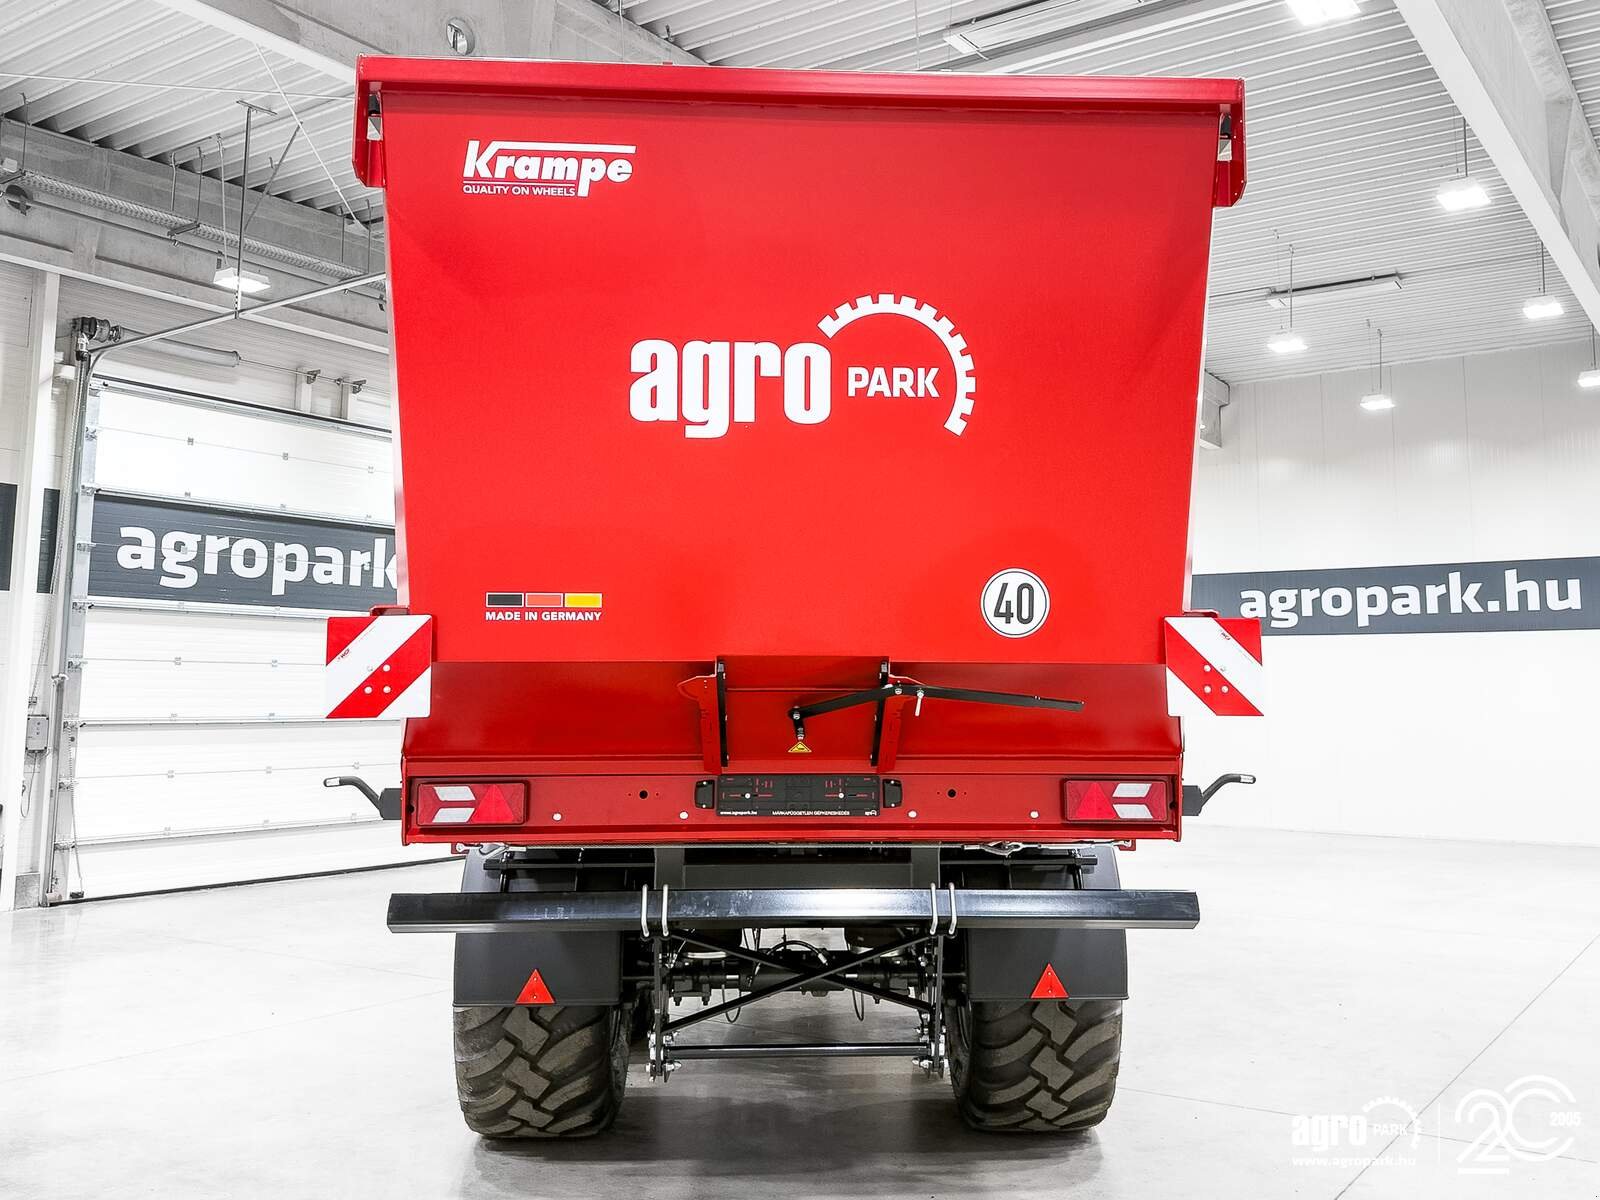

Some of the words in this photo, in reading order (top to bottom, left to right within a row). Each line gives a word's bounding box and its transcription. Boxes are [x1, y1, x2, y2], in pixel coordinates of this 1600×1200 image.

[463, 140, 637, 197] Krampe
[463, 184, 509, 195] QUALITY
[512, 186, 529, 195] ON
[532, 187, 576, 197] WHEELS
[629, 338, 831, 438] agro
[847, 367, 940, 398] PARK
[485, 611, 521, 621] MADE
[525, 611, 538, 621] IN
[541, 611, 602, 621] GERMANY
[993, 582, 1034, 625] 40
[1240, 569, 1582, 628] agropark.hu
